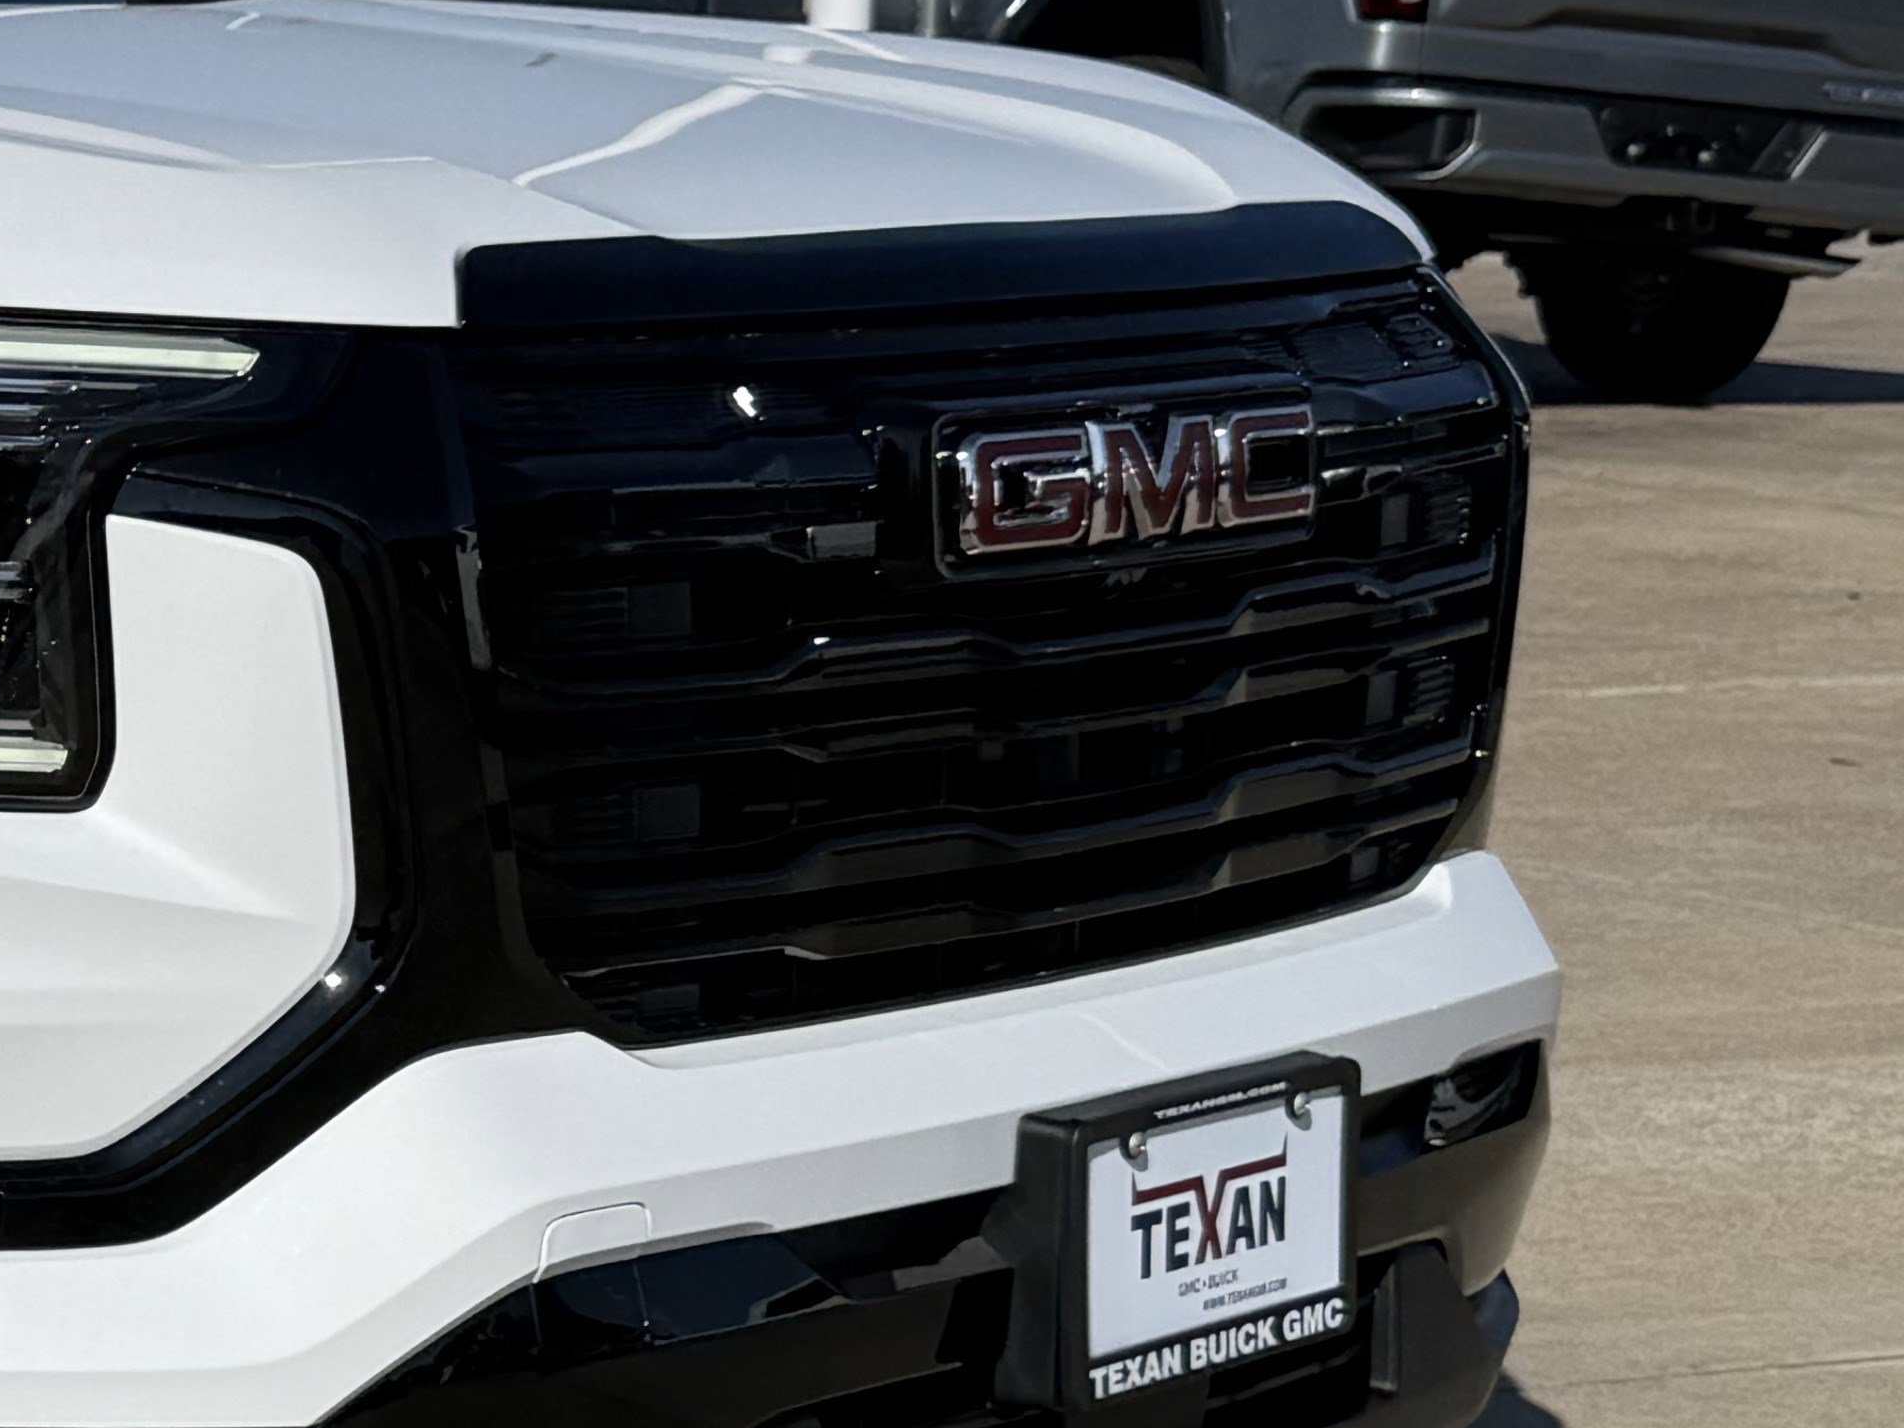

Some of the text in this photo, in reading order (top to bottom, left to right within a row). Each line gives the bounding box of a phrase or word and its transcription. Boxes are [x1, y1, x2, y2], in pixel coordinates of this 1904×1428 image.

[960, 406, 1315, 556] GMC
[1130, 1170, 1288, 1280] TEXAN
[1090, 1297, 1345, 1400] TEXAN BUICK GMC
